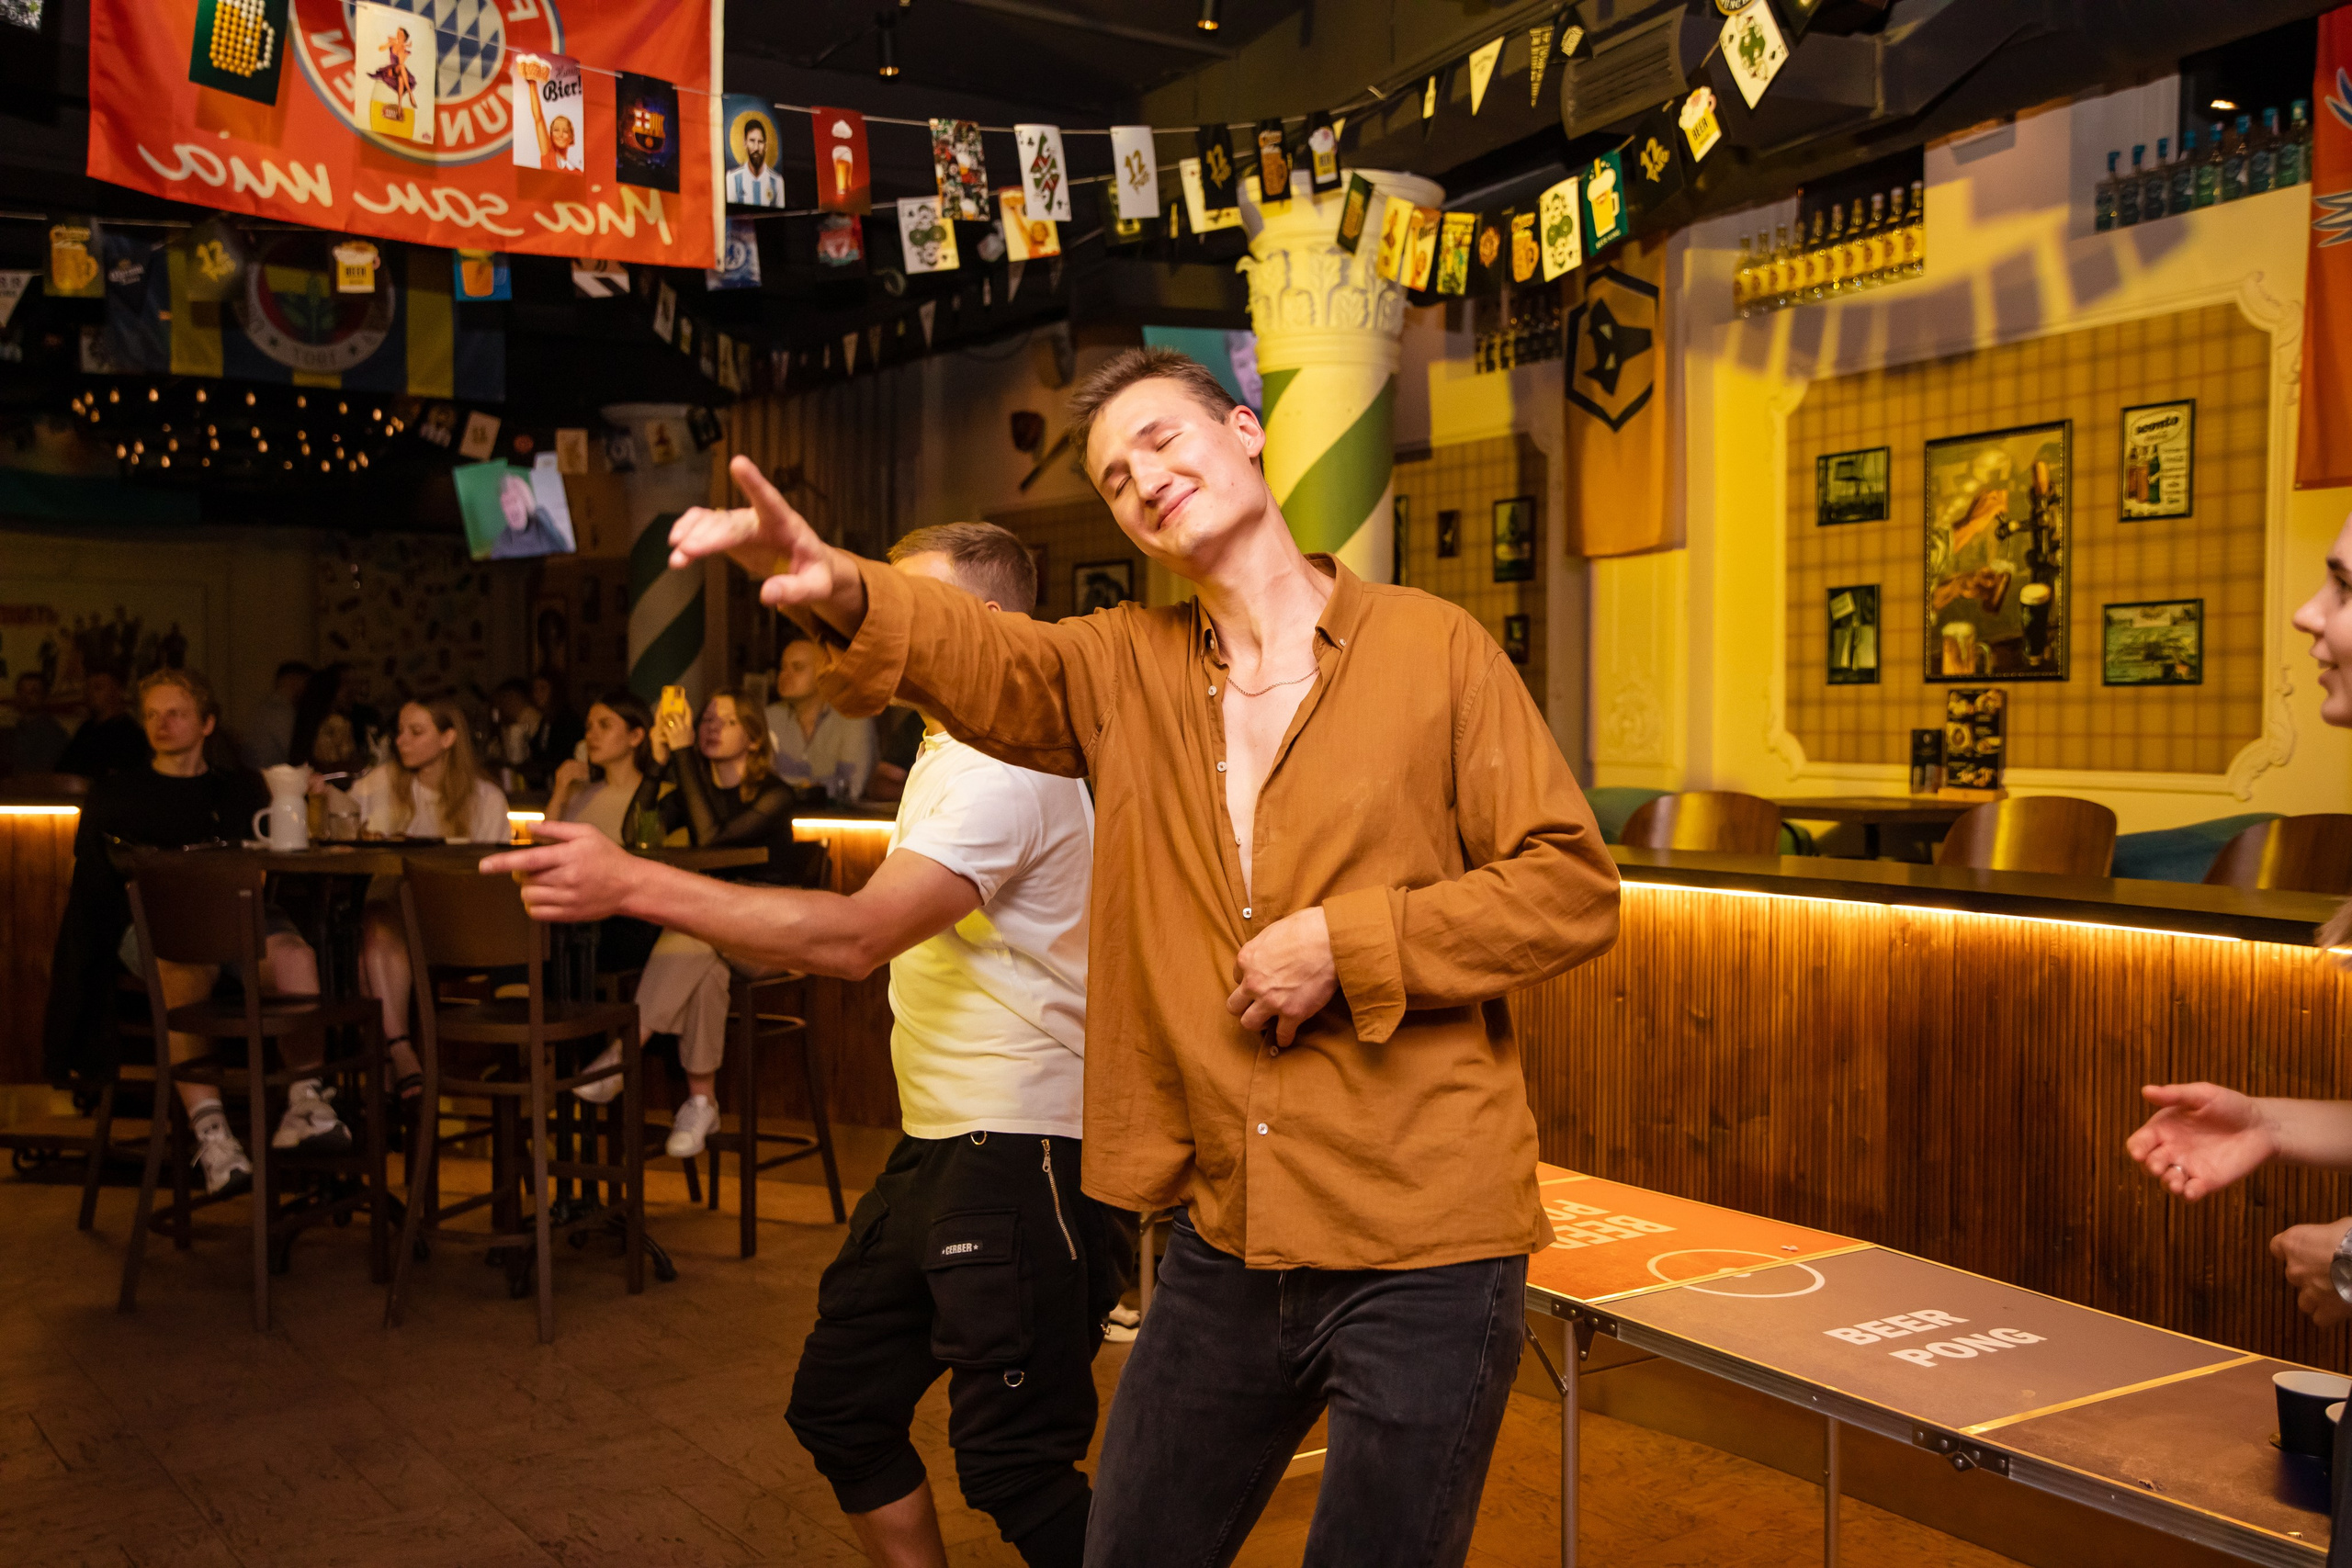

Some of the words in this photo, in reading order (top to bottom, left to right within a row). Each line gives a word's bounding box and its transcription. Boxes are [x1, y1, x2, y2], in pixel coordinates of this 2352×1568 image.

[542, 74, 582, 102] Bier!
[1822, 1309, 1970, 1345] BEER
[1888, 1328, 2048, 1367] PONG
